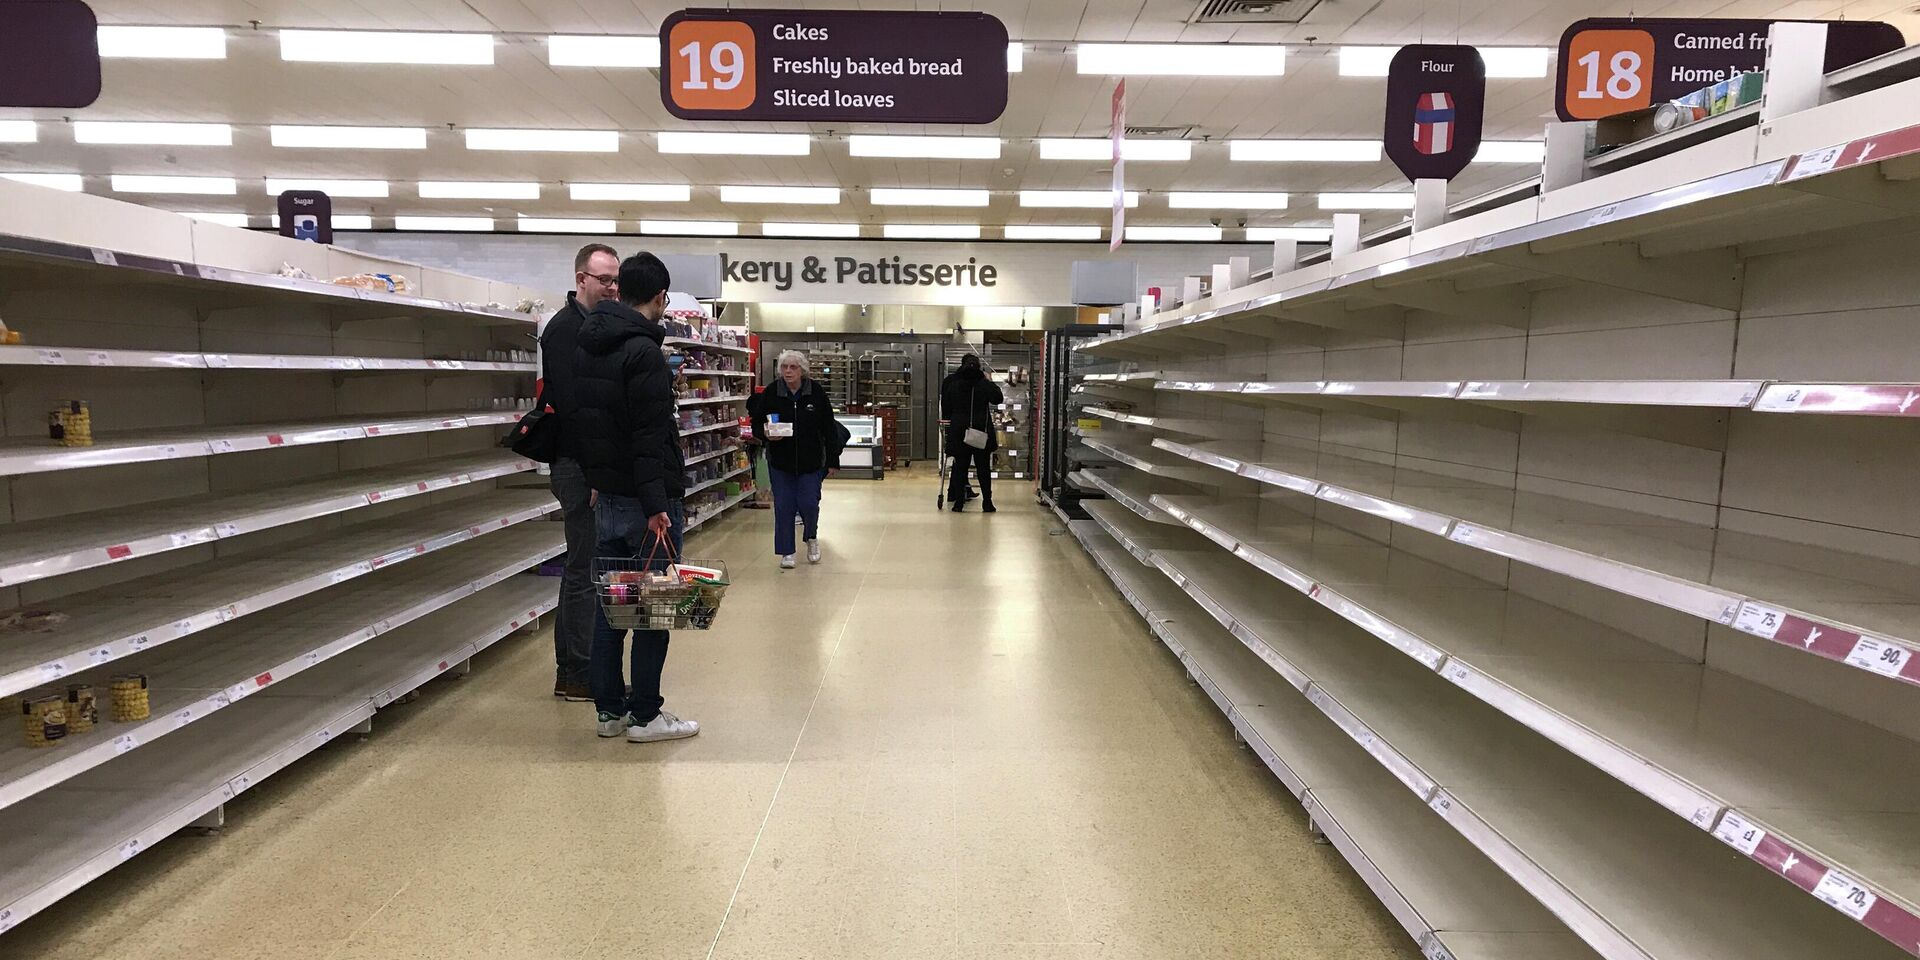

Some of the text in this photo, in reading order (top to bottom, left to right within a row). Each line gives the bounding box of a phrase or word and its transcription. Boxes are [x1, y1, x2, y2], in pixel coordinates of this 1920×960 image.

[773, 23, 829, 41] Cakes
[1674, 32, 1744, 50] Canned
[678, 41, 745, 91] 19
[773, 57, 963, 79] Freshly baked bread
[1421, 60, 1455, 73] Flour
[1577, 50, 1643, 100] 18
[1671, 66, 1726, 83] Home
[773, 89, 895, 108] Sliced loaves
[294, 197, 314, 206] Sugar
[720, 252, 998, 292] kery & Patisserie
[1760, 612, 1777, 629] 75p
[1880, 647, 1901, 667] 90p
[1743, 830, 1756, 842] £1
[1846, 886, 1866, 908] 70p
